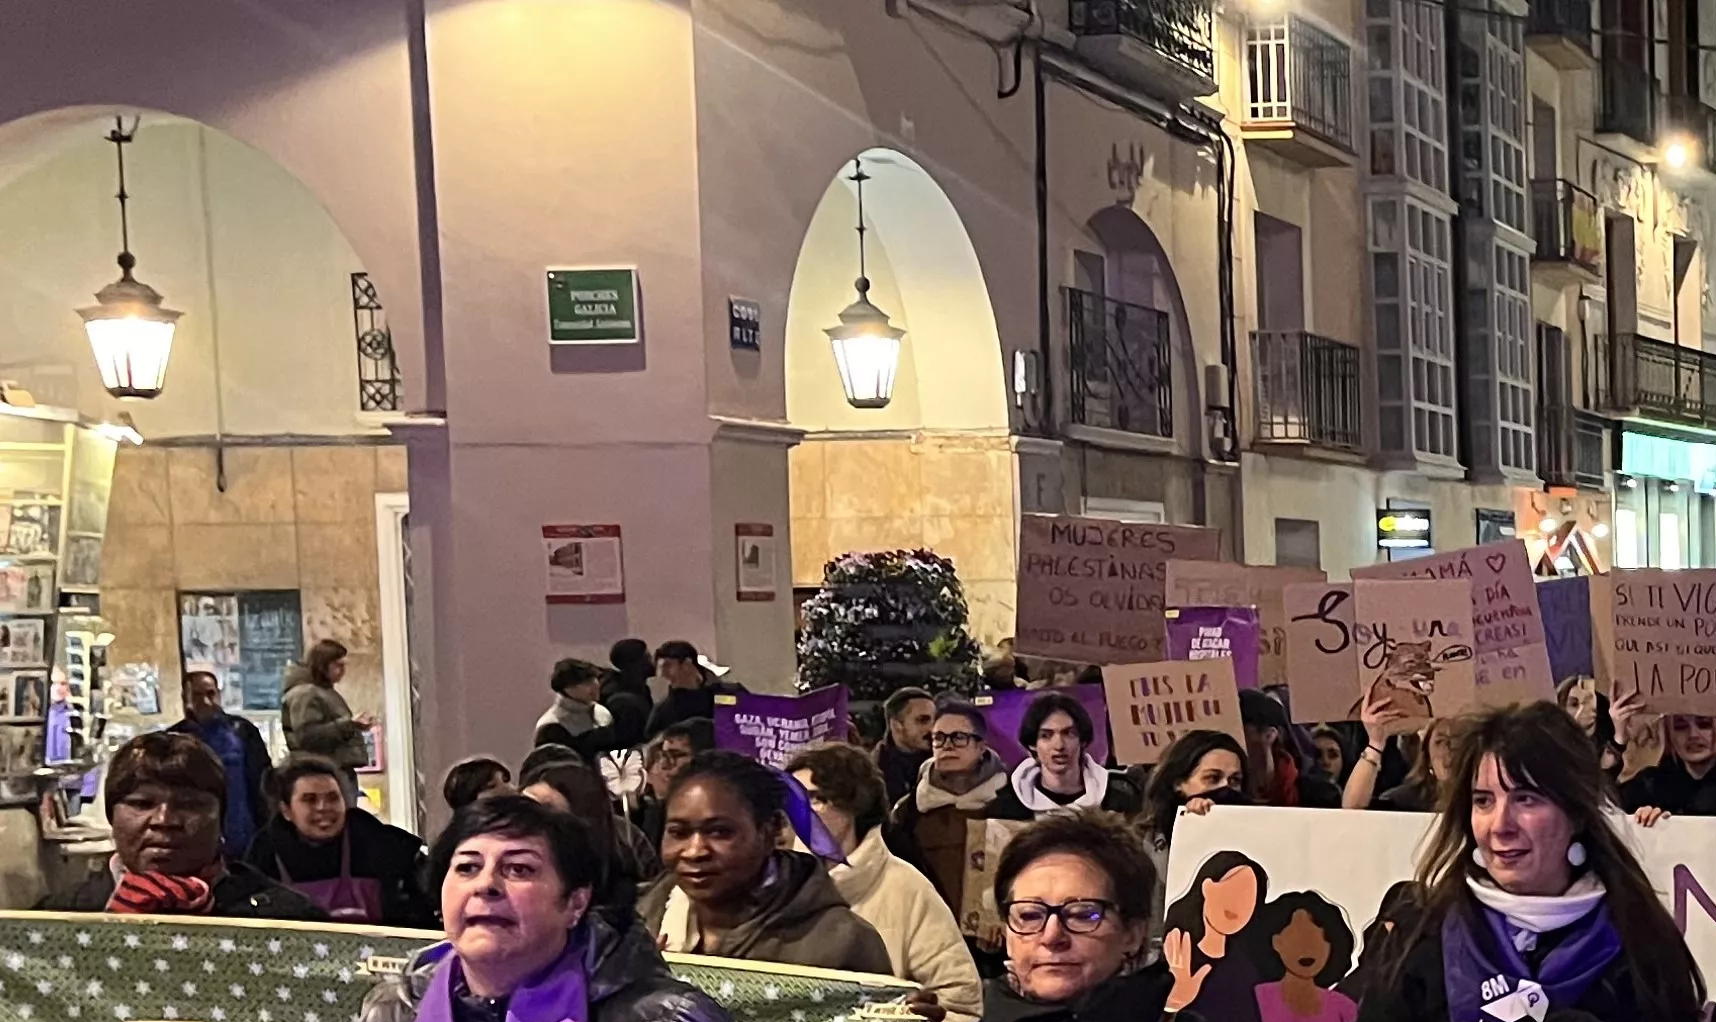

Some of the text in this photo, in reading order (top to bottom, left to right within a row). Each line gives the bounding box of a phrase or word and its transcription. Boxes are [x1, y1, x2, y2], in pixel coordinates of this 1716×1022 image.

[574, 304, 616, 315] GALICIA
[1051, 524, 1175, 553] MUJERES
[1666, 618, 1686, 629] UN
[1481, 974, 1510, 1001] 8M
